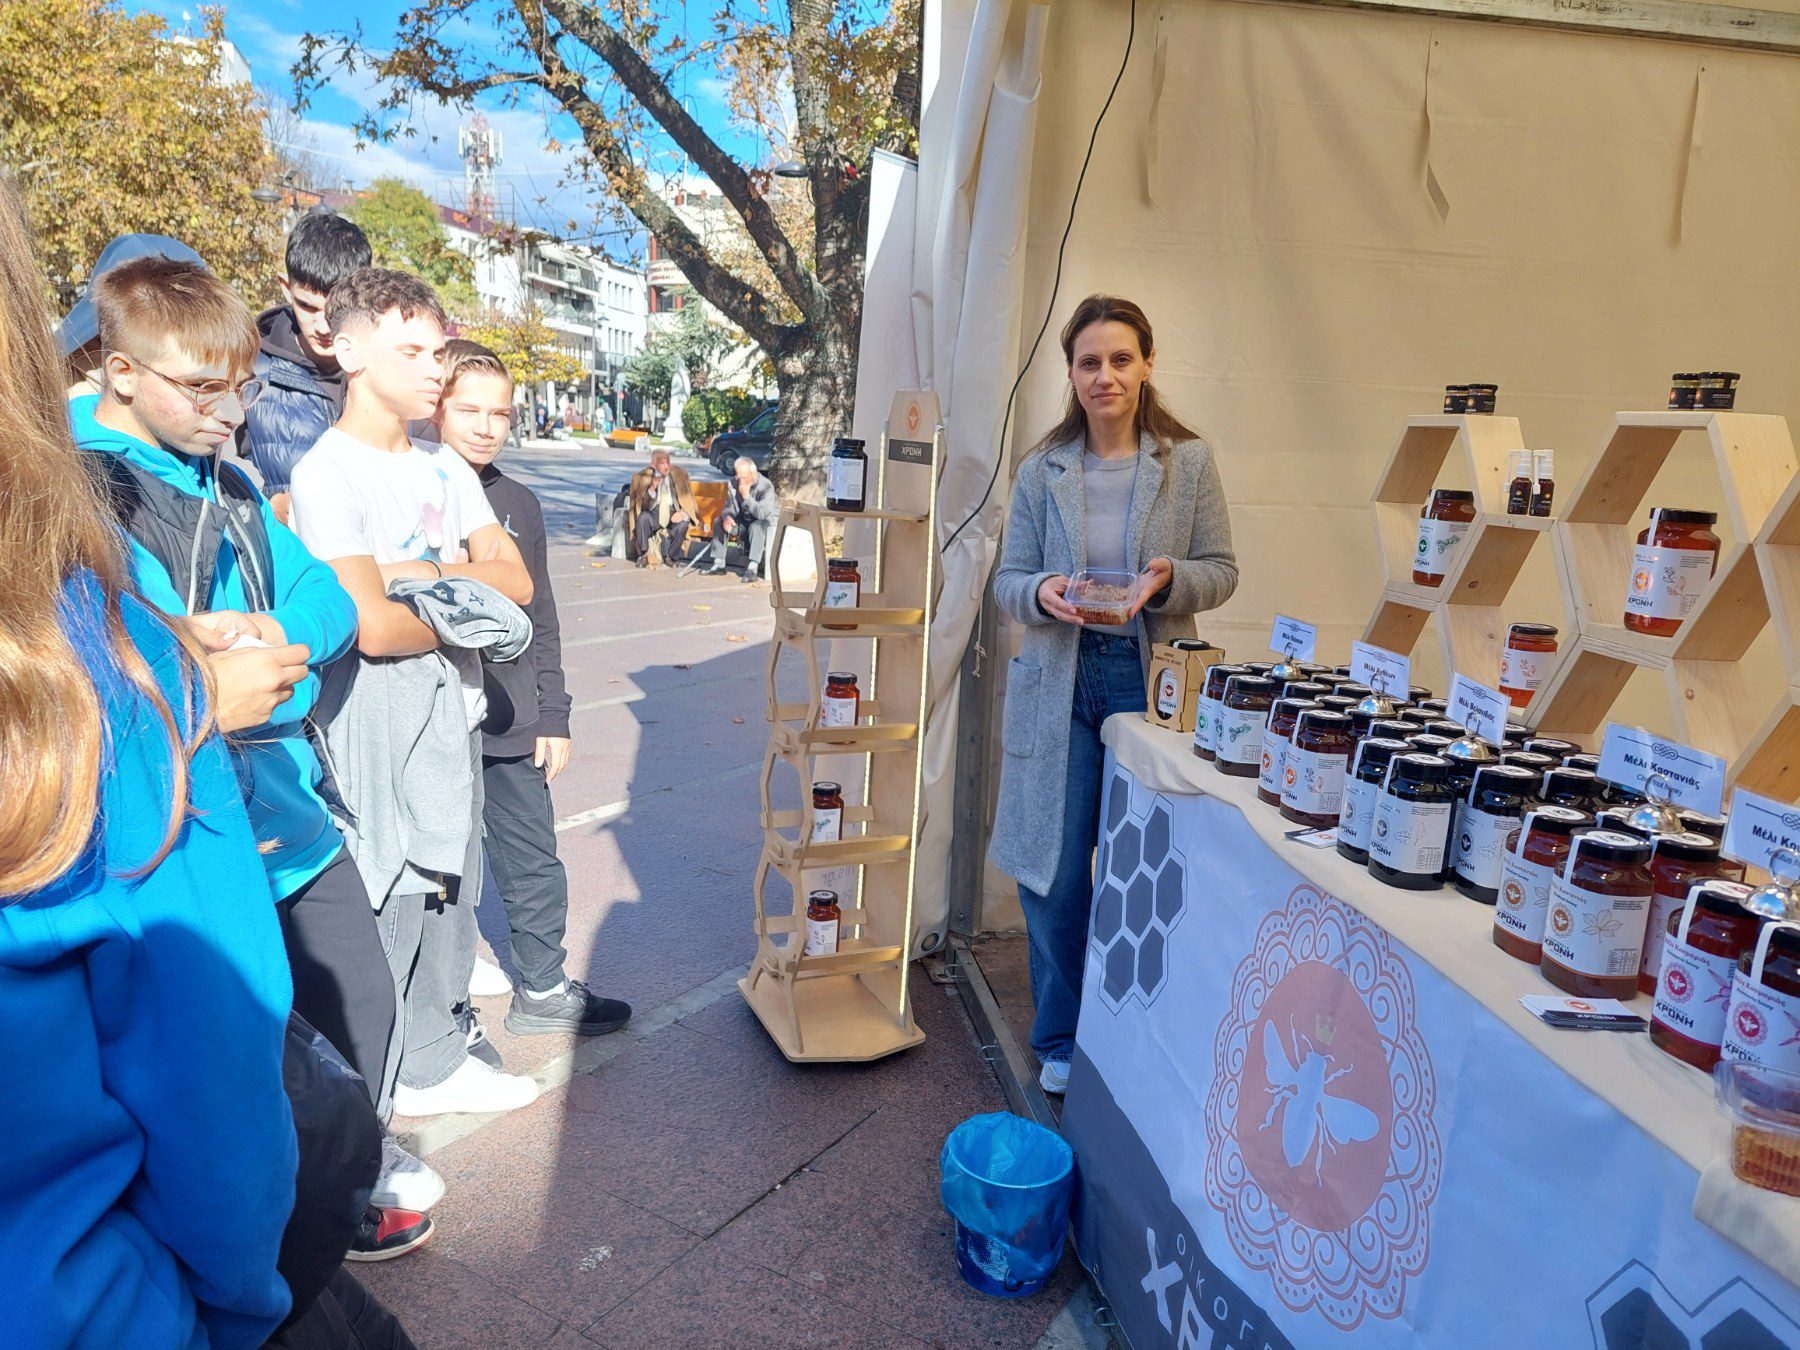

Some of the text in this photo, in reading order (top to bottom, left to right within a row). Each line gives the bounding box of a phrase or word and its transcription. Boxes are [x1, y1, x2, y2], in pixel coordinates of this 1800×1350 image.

[1624, 753, 1701, 790] Μέλι Καστανιάς
[1752, 824, 1777, 843] Μέλι
